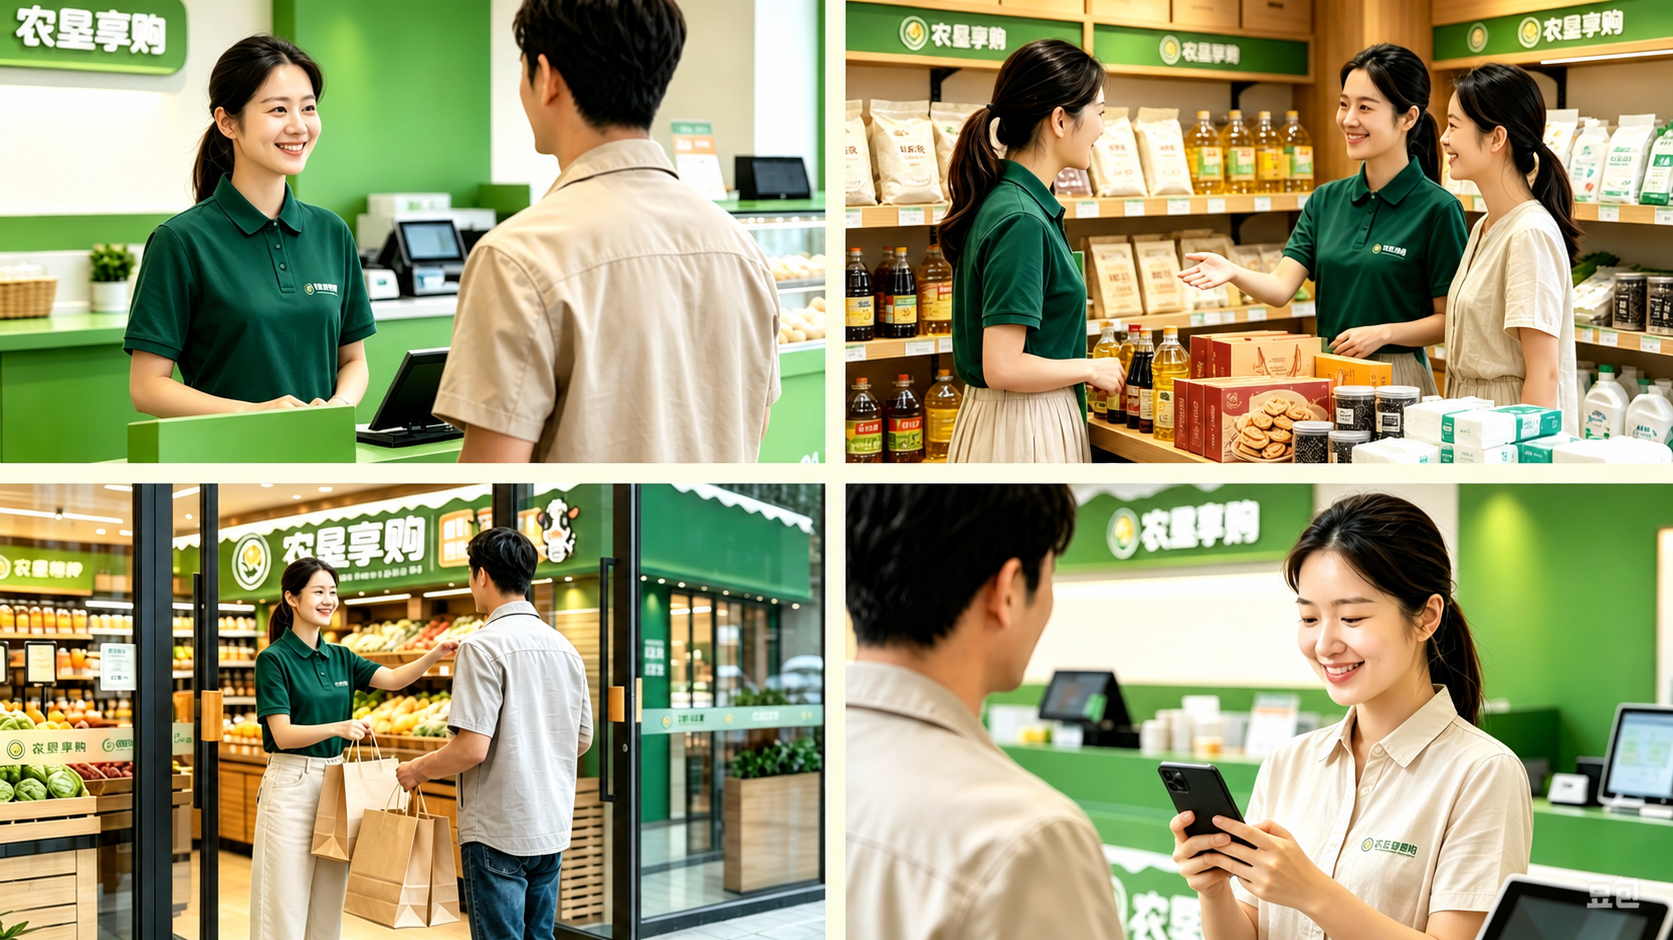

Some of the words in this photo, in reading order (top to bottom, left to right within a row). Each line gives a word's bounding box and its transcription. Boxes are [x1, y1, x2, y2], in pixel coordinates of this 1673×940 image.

[16, 5, 166, 55] 农垦享购
[931, 22, 1006, 50] 农垦享购
[1543, 9, 1624, 42] 农垦享购
[282, 515, 426, 568] 农垦享购
[1140, 499, 1260, 552] 农垦享购
